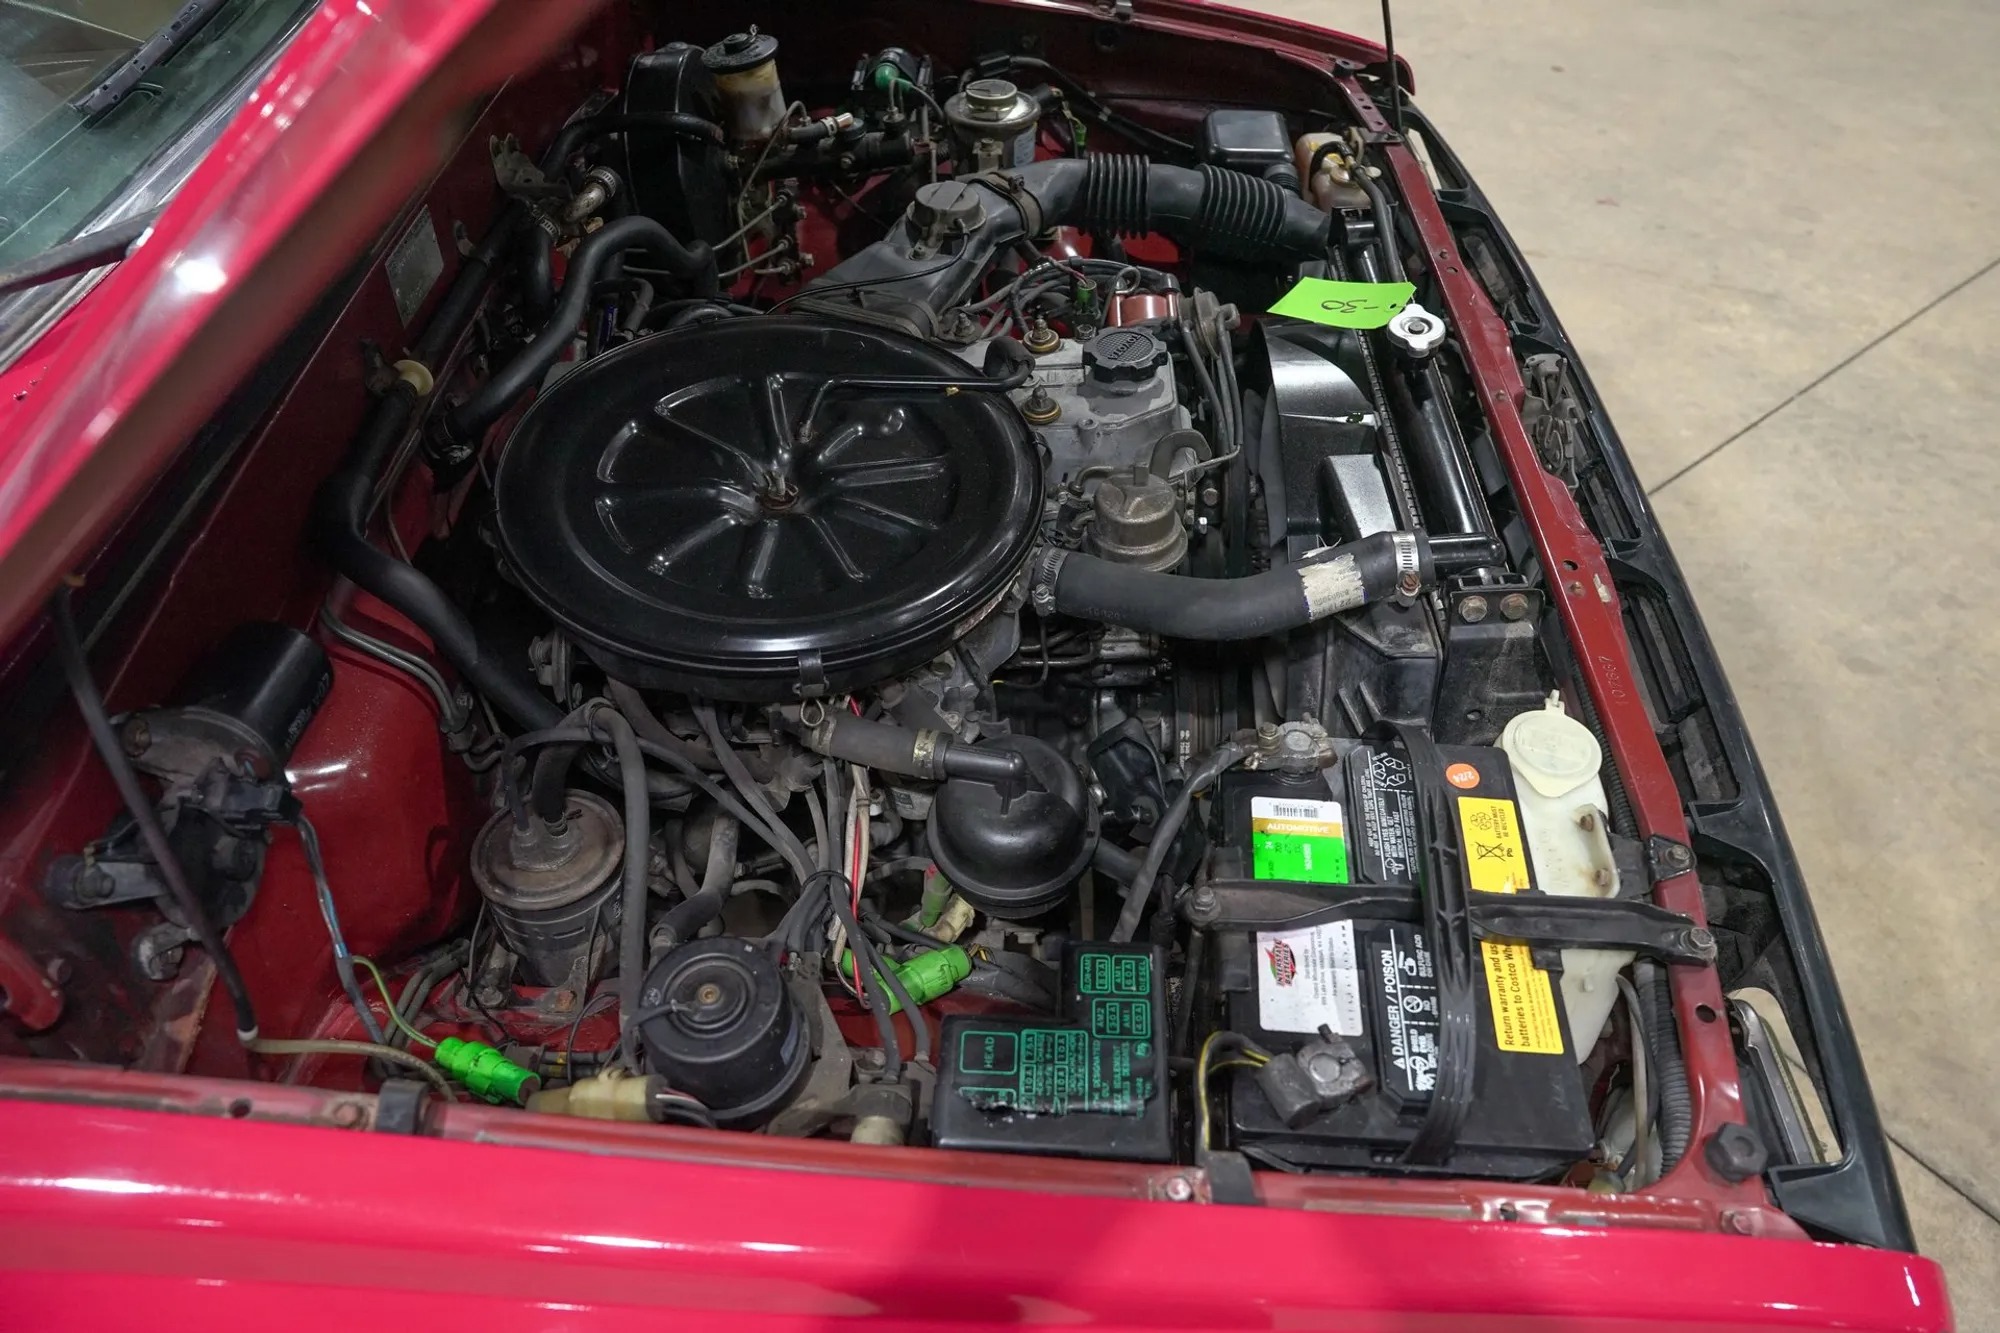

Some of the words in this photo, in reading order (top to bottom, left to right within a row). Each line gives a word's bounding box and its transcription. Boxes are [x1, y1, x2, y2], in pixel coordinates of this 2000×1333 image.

[1106, 332, 1140, 361] TOYOTA
[1378, 797, 1387, 826] IMMEDIATELY
[1499, 808, 1508, 831] RECYCLED
[1267, 823, 1329, 833] AUTOMOTIVE
[1493, 819, 1502, 839] BATTERY
[1506, 847, 1514, 857] Pb
[1273, 938, 1284, 986] INTERSTATE
[1282, 943, 1291, 984] BATTERIES
[1381, 949, 1396, 993] POISON
[1492, 957, 1501, 972] and
[1508, 963, 1519, 992] Costco
[1496, 975, 1509, 1013] warranty
[1514, 995, 1522, 1004] to
[1388, 1005, 1403, 1056] DANGER
[1502, 1015, 1514, 1045] Return
[1517, 1006, 1530, 1047] batteries
[984, 1036, 995, 1069] HEAD
